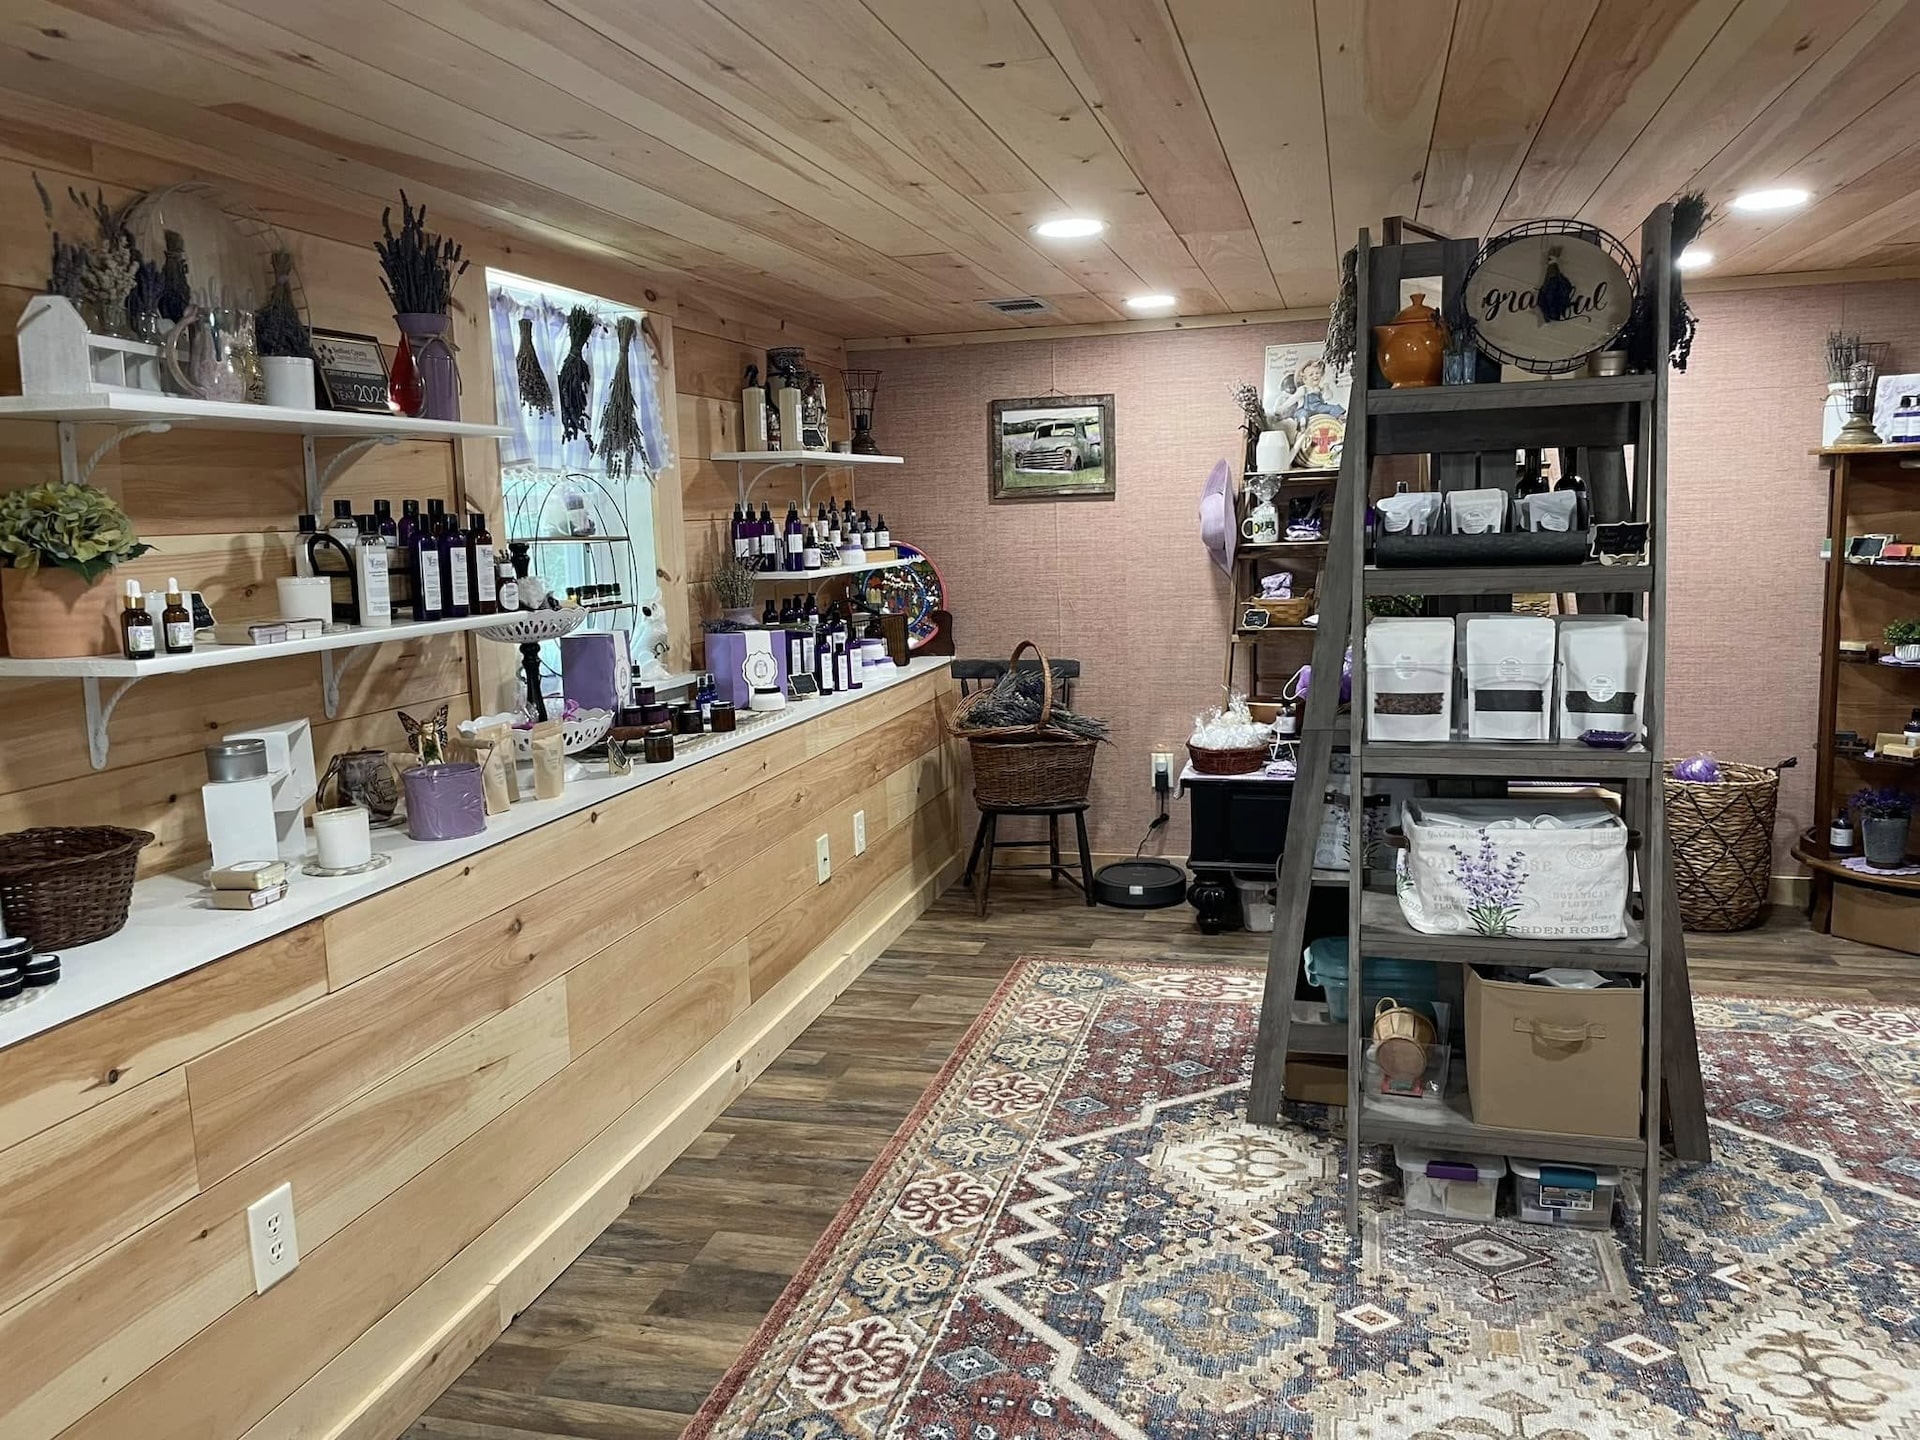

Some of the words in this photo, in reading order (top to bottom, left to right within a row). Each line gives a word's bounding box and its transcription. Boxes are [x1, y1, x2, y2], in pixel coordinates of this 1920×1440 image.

[1481, 281, 1608, 322] graful
[1509, 925, 1564, 935] ARDEN
[1569, 925, 1610, 934] ROSE
